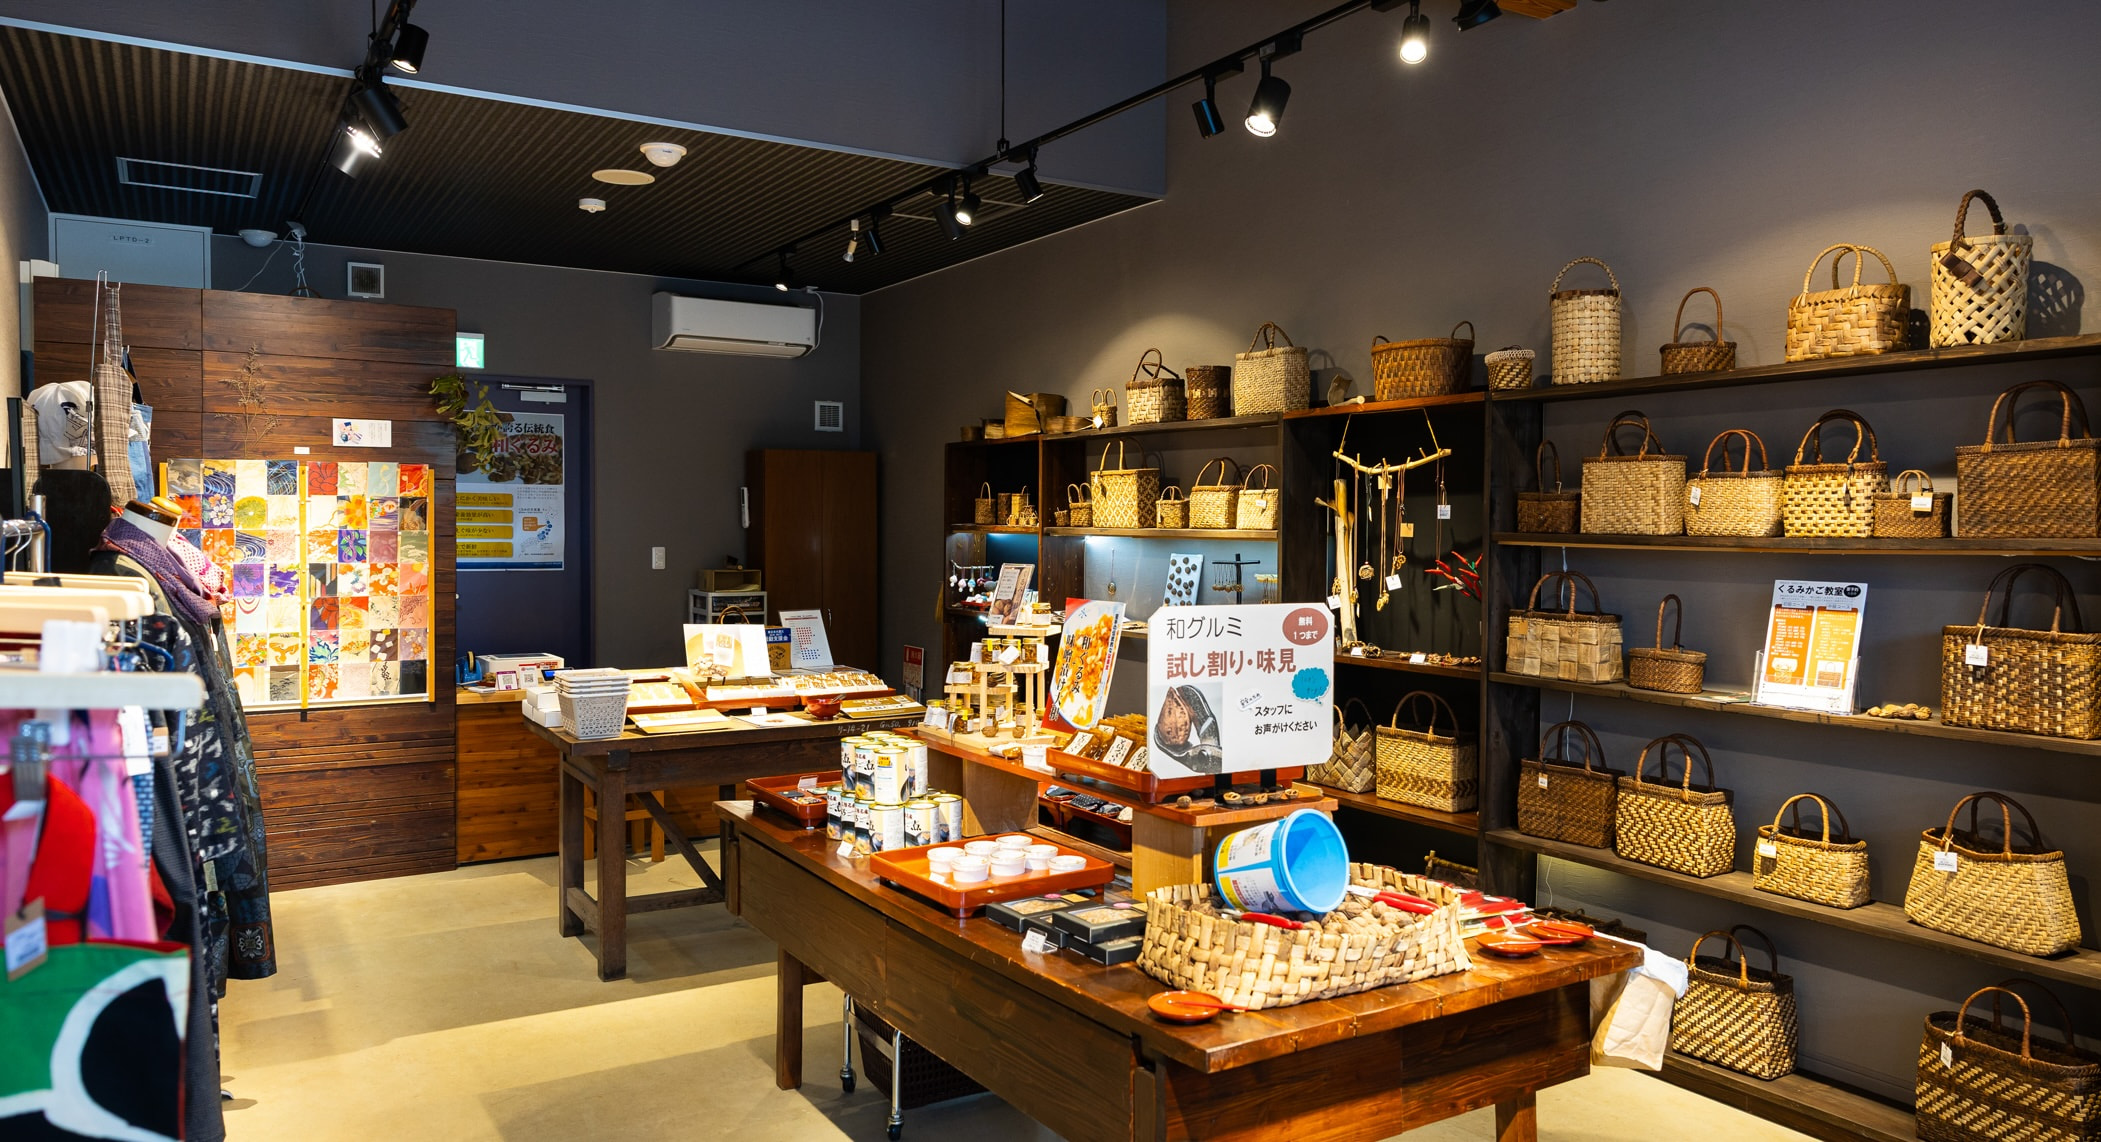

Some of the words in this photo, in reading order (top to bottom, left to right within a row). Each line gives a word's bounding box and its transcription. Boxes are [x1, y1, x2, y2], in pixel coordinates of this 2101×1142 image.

[1778, 584, 1843, 596] くるみかご教室
[1166, 616, 1243, 640] 和グルミ
[1298, 615, 1313, 626] 無料
[1072, 635, 1092, 693] 和ぐるみ
[1166, 648, 1297, 680] 試し割り・味見
[1255, 704, 1293, 717] スタッフに
[1254, 720, 1318, 735] お声がけください
